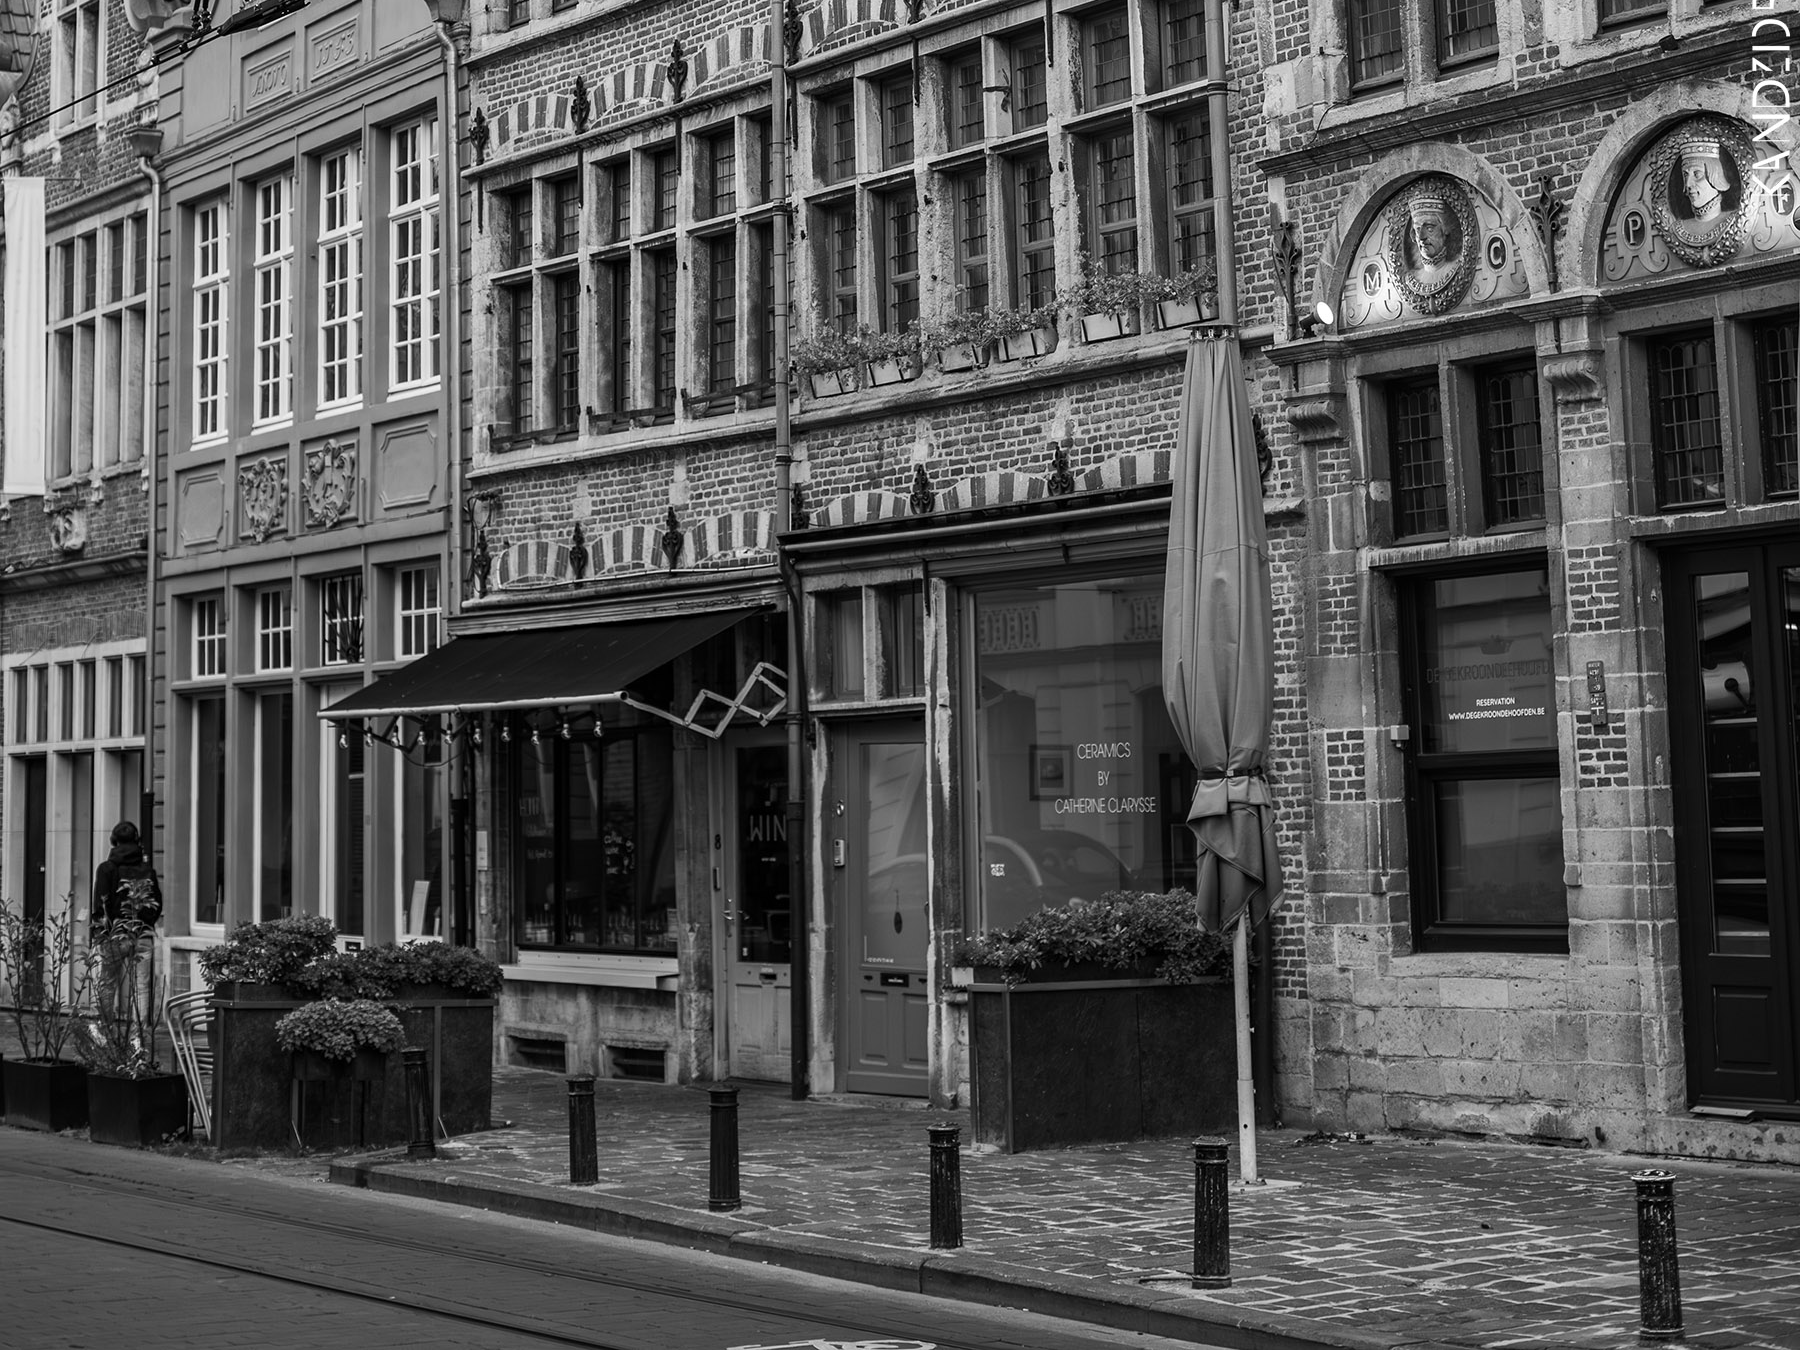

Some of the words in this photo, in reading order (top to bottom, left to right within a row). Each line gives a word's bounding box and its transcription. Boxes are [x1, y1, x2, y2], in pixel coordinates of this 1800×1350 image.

[1628, 215, 1643, 244] P
[1363, 271, 1382, 291] M
[1489, 239, 1504, 265] C
[1476, 697, 1515, 707] RESERVATION
[1448, 706, 1545, 721] WWW.DEGEKROONDEHOOFDEN.BE
[1077, 742, 1131, 760] CERAMICS
[1097, 770, 1110, 786] BY
[1054, 797, 1106, 815] CATHERINE
[1107, 796, 1156, 814] CLARYSSE
